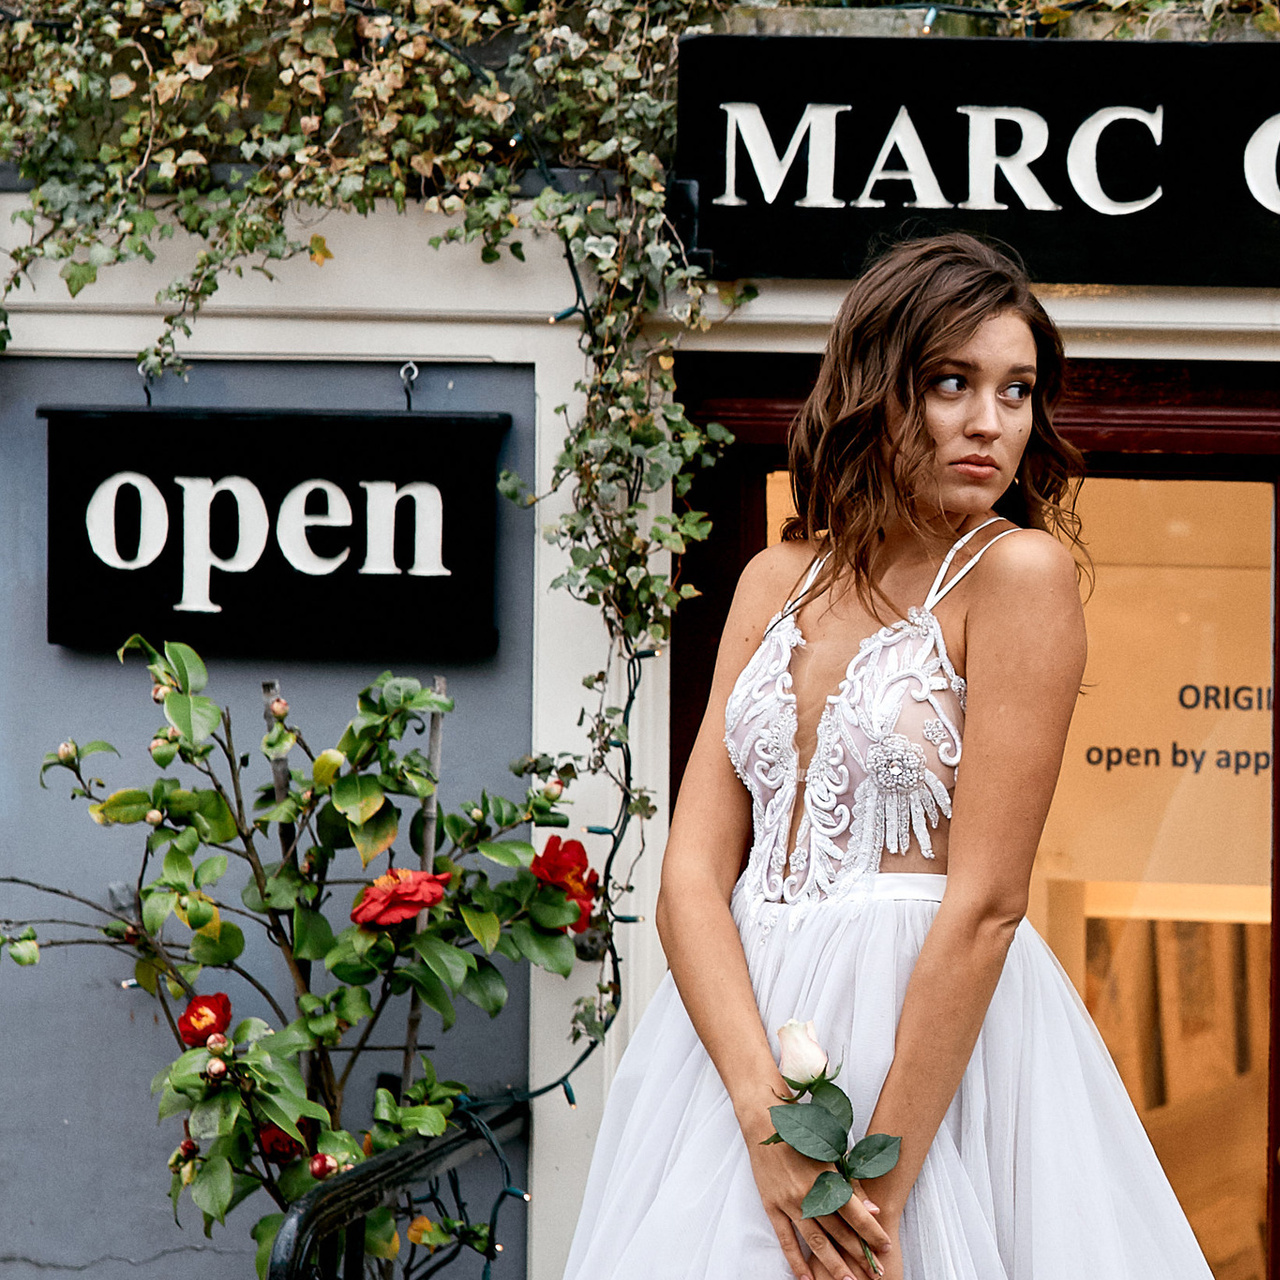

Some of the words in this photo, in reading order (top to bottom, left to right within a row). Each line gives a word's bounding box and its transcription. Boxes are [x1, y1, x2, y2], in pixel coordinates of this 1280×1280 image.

[710, 101, 1165, 216] MARC
[85, 471, 453, 614] open
[1085, 744, 1161, 771] open
[1171, 741, 1207, 774] by
